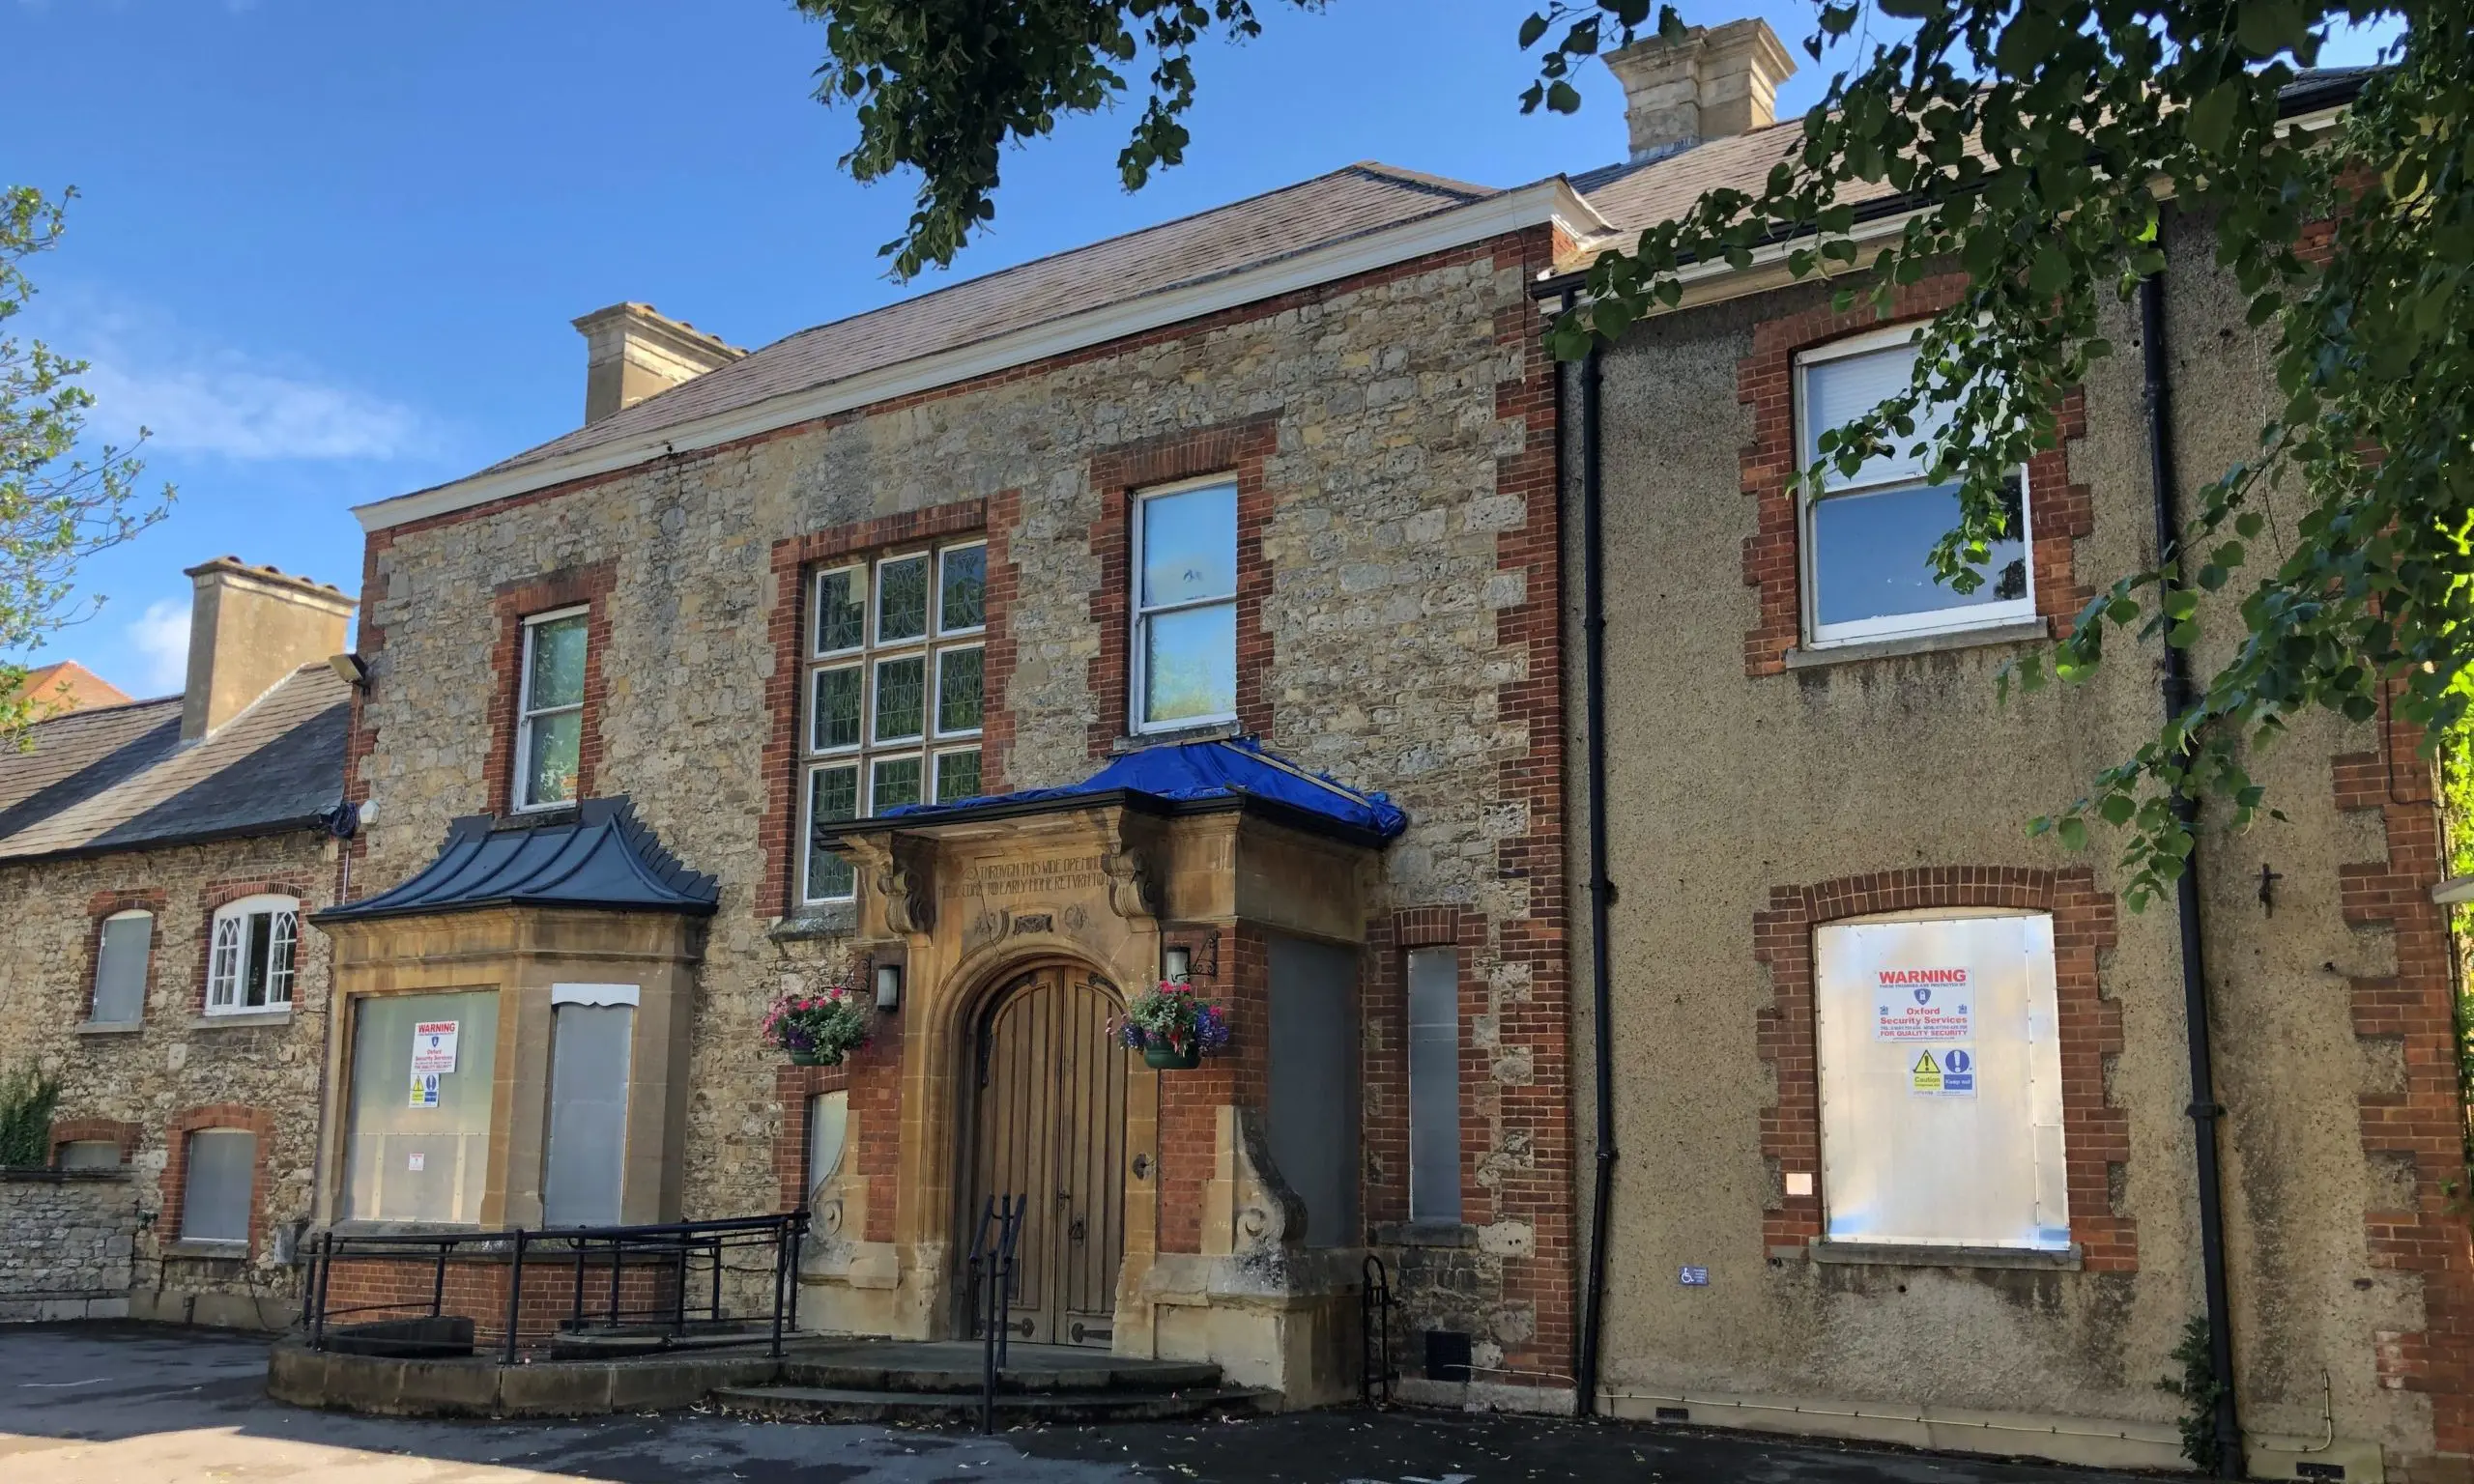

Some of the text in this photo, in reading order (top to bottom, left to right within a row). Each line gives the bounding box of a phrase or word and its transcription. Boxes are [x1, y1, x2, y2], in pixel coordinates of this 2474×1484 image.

[1879, 969, 1966, 984] WARNING
[1880, 1015, 1968, 1025] Security Services
[417, 1023, 455, 1033] WARNING
